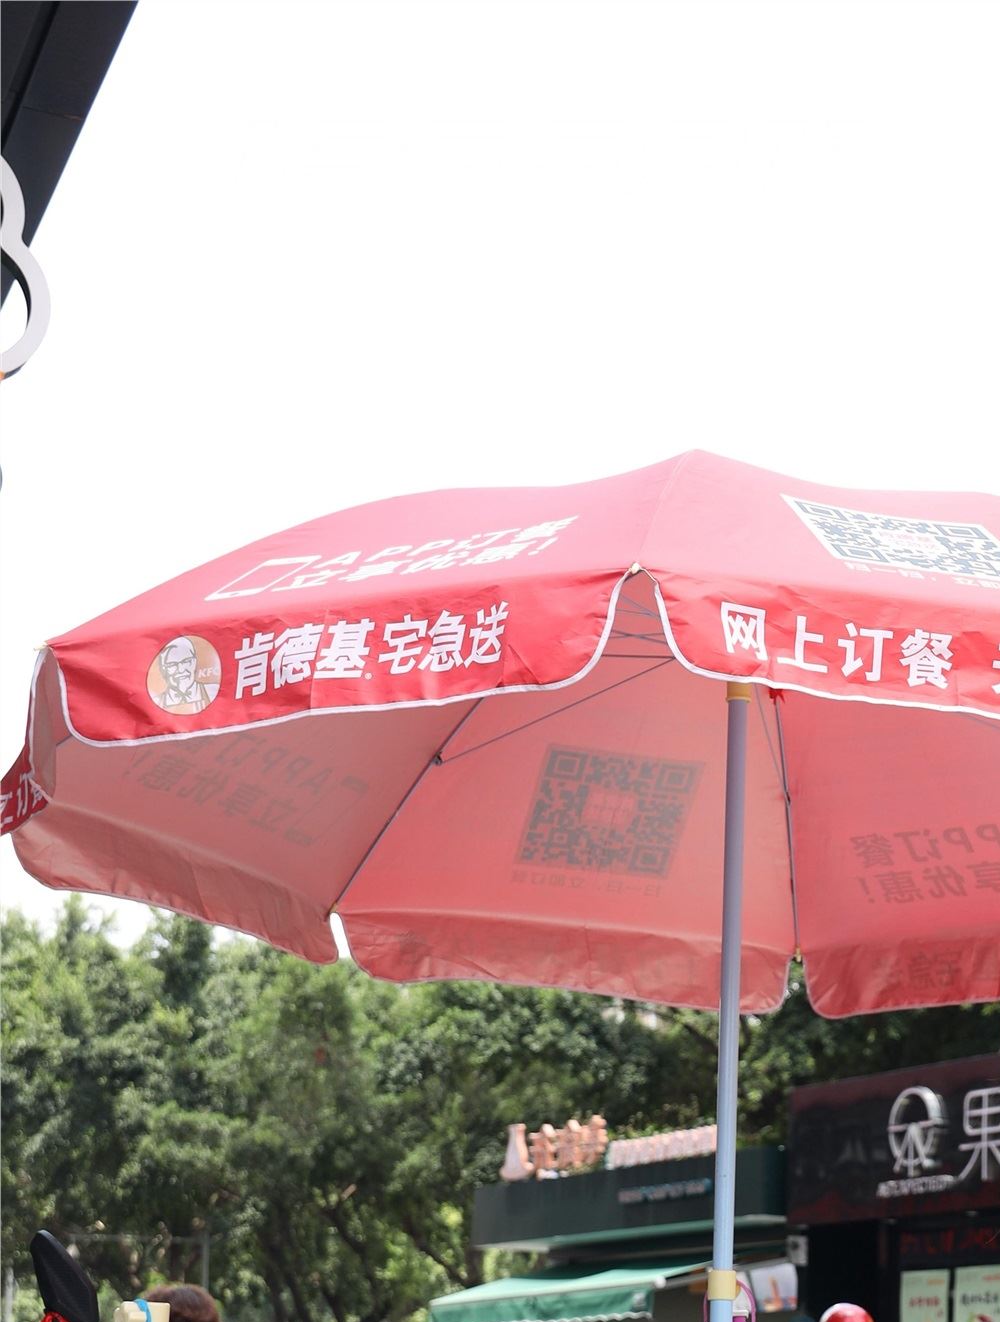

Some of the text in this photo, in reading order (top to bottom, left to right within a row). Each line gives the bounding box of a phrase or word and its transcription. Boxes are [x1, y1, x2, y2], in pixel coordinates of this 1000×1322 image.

[234, 603, 508, 699] 肯德基 宅急送
[721, 602, 953, 690] 网上订餐
